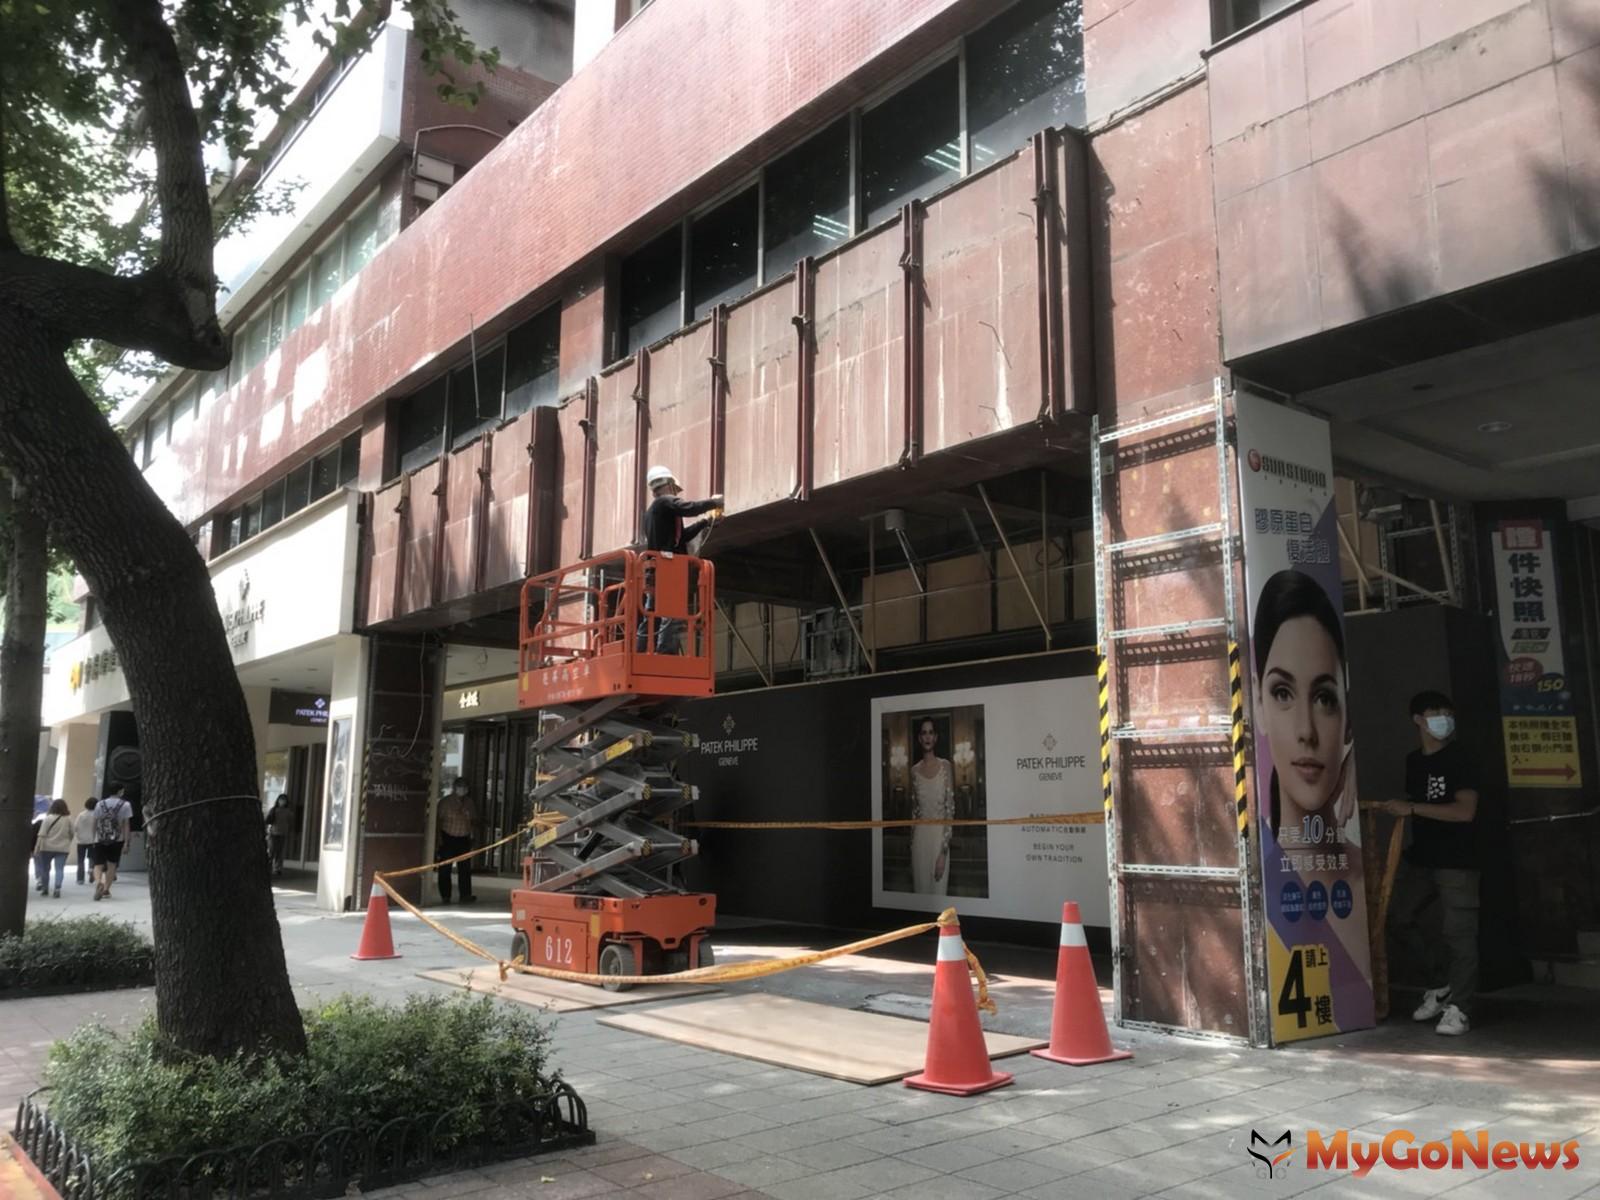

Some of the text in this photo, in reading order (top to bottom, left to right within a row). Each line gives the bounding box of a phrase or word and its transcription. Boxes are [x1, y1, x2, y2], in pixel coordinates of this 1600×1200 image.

[701, 737, 758, 754] PATEK PHILIPPE
[1016, 755, 1086, 770] PATEK PHILIPPE
[1038, 772, 1062, 781] GENEVE
[1033, 843, 1074, 852] BEGIN YOUR
[1025, 854, 1083, 863] OWN TRADITION
[546, 935, 572, 964] 612
[1278, 949, 1312, 1028] 4
